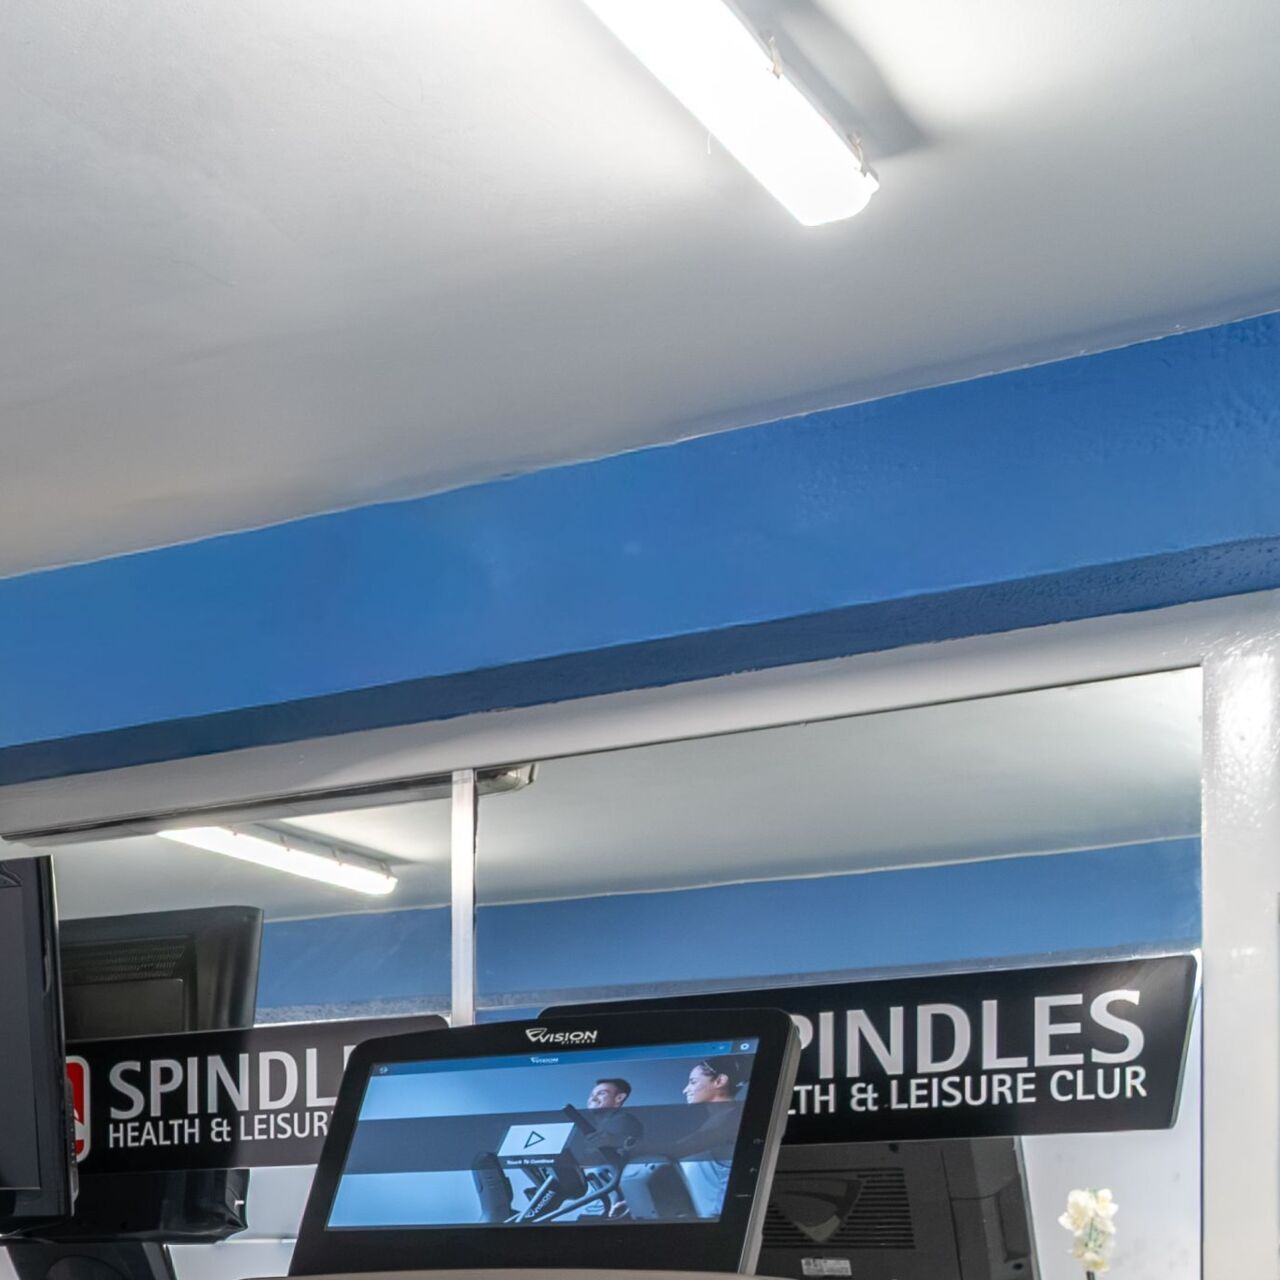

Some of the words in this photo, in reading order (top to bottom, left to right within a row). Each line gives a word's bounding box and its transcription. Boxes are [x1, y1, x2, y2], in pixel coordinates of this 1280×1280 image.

[109, 1046, 357, 1120] SPINDL
[850, 1082, 878, 1112] &
[890, 1070, 1037, 1110] LEISURE
[109, 1118, 200, 1148] HEALTH
[210, 1118, 231, 1142] &
[240, 1111, 334, 1141] LEISUR
